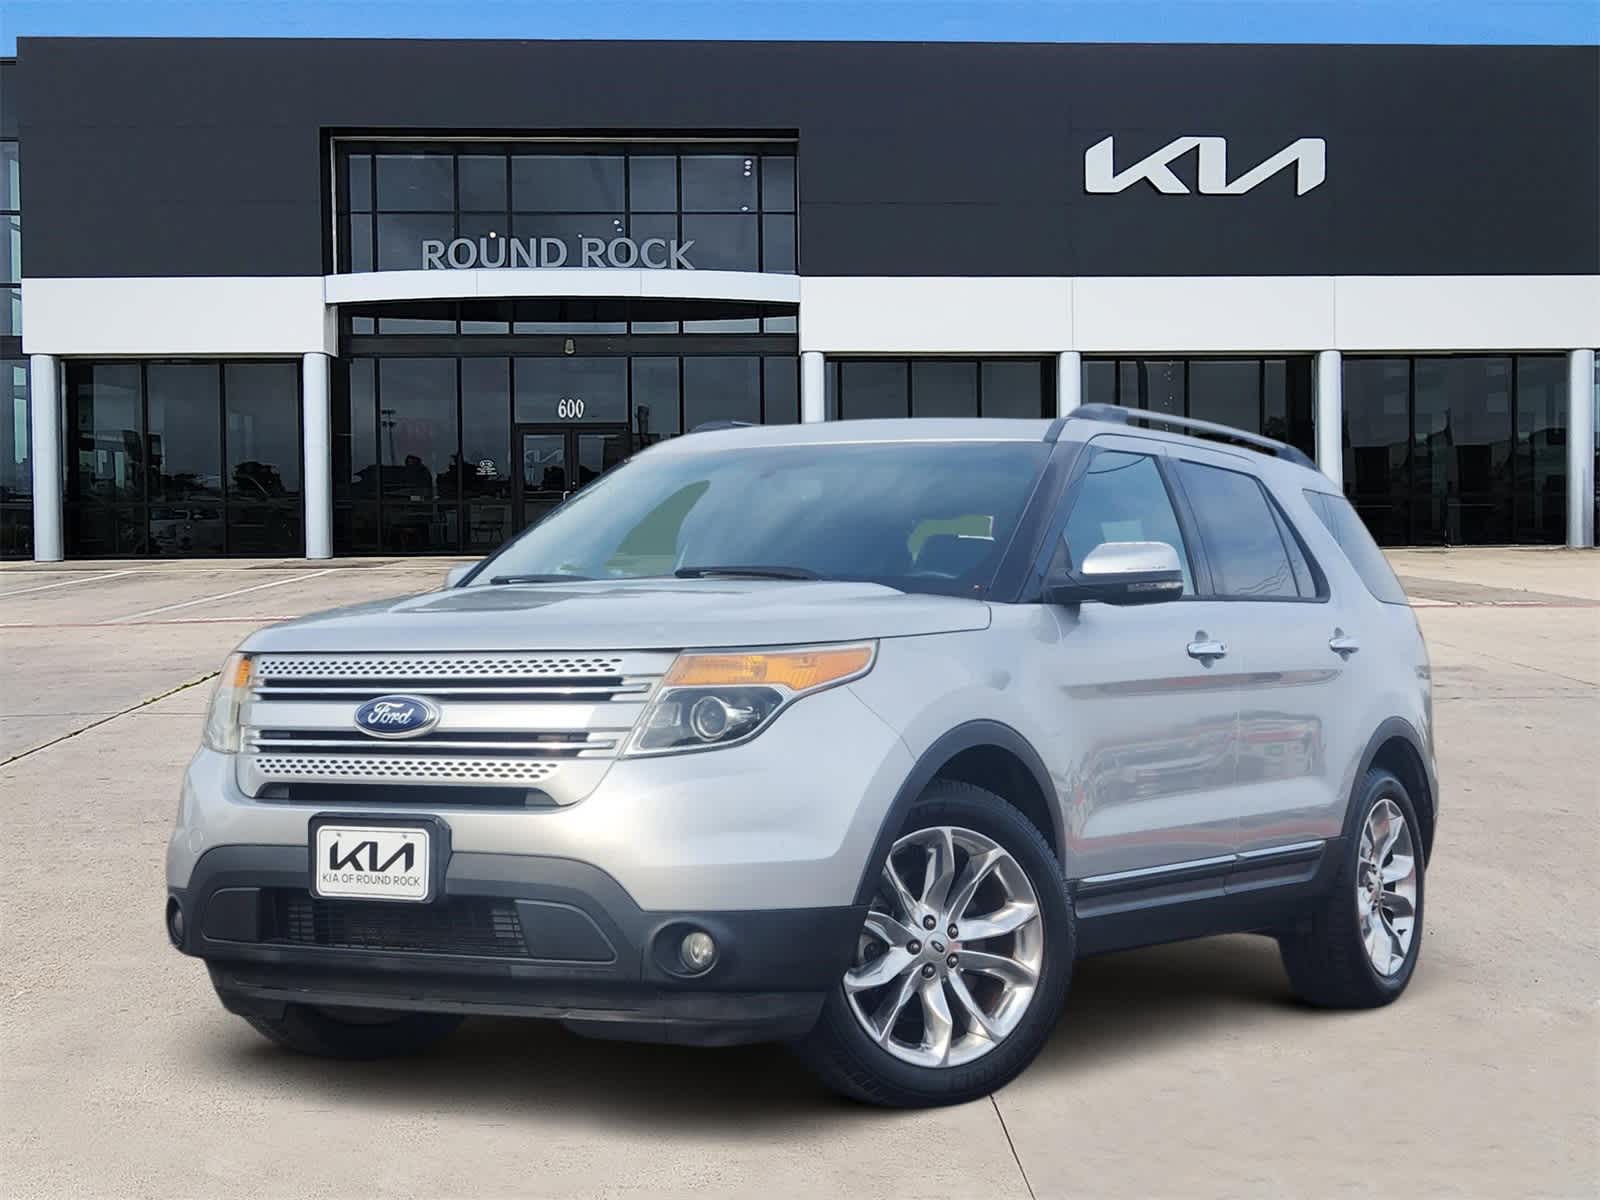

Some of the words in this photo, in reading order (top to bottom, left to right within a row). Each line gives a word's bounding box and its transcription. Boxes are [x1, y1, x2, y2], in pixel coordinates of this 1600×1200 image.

[1085, 135, 1326, 196] KIA
[422, 237, 568, 270] ROUND
[581, 237, 696, 270] ROCK
[558, 399, 584, 418] 600
[367, 701, 415, 724] Ford
[329, 840, 415, 873] KIA
[322, 873, 339, 882] KIA
[341, 873, 355, 884] OF
[356, 874, 391, 885] ROUND
[393, 876, 421, 887] ROCK
